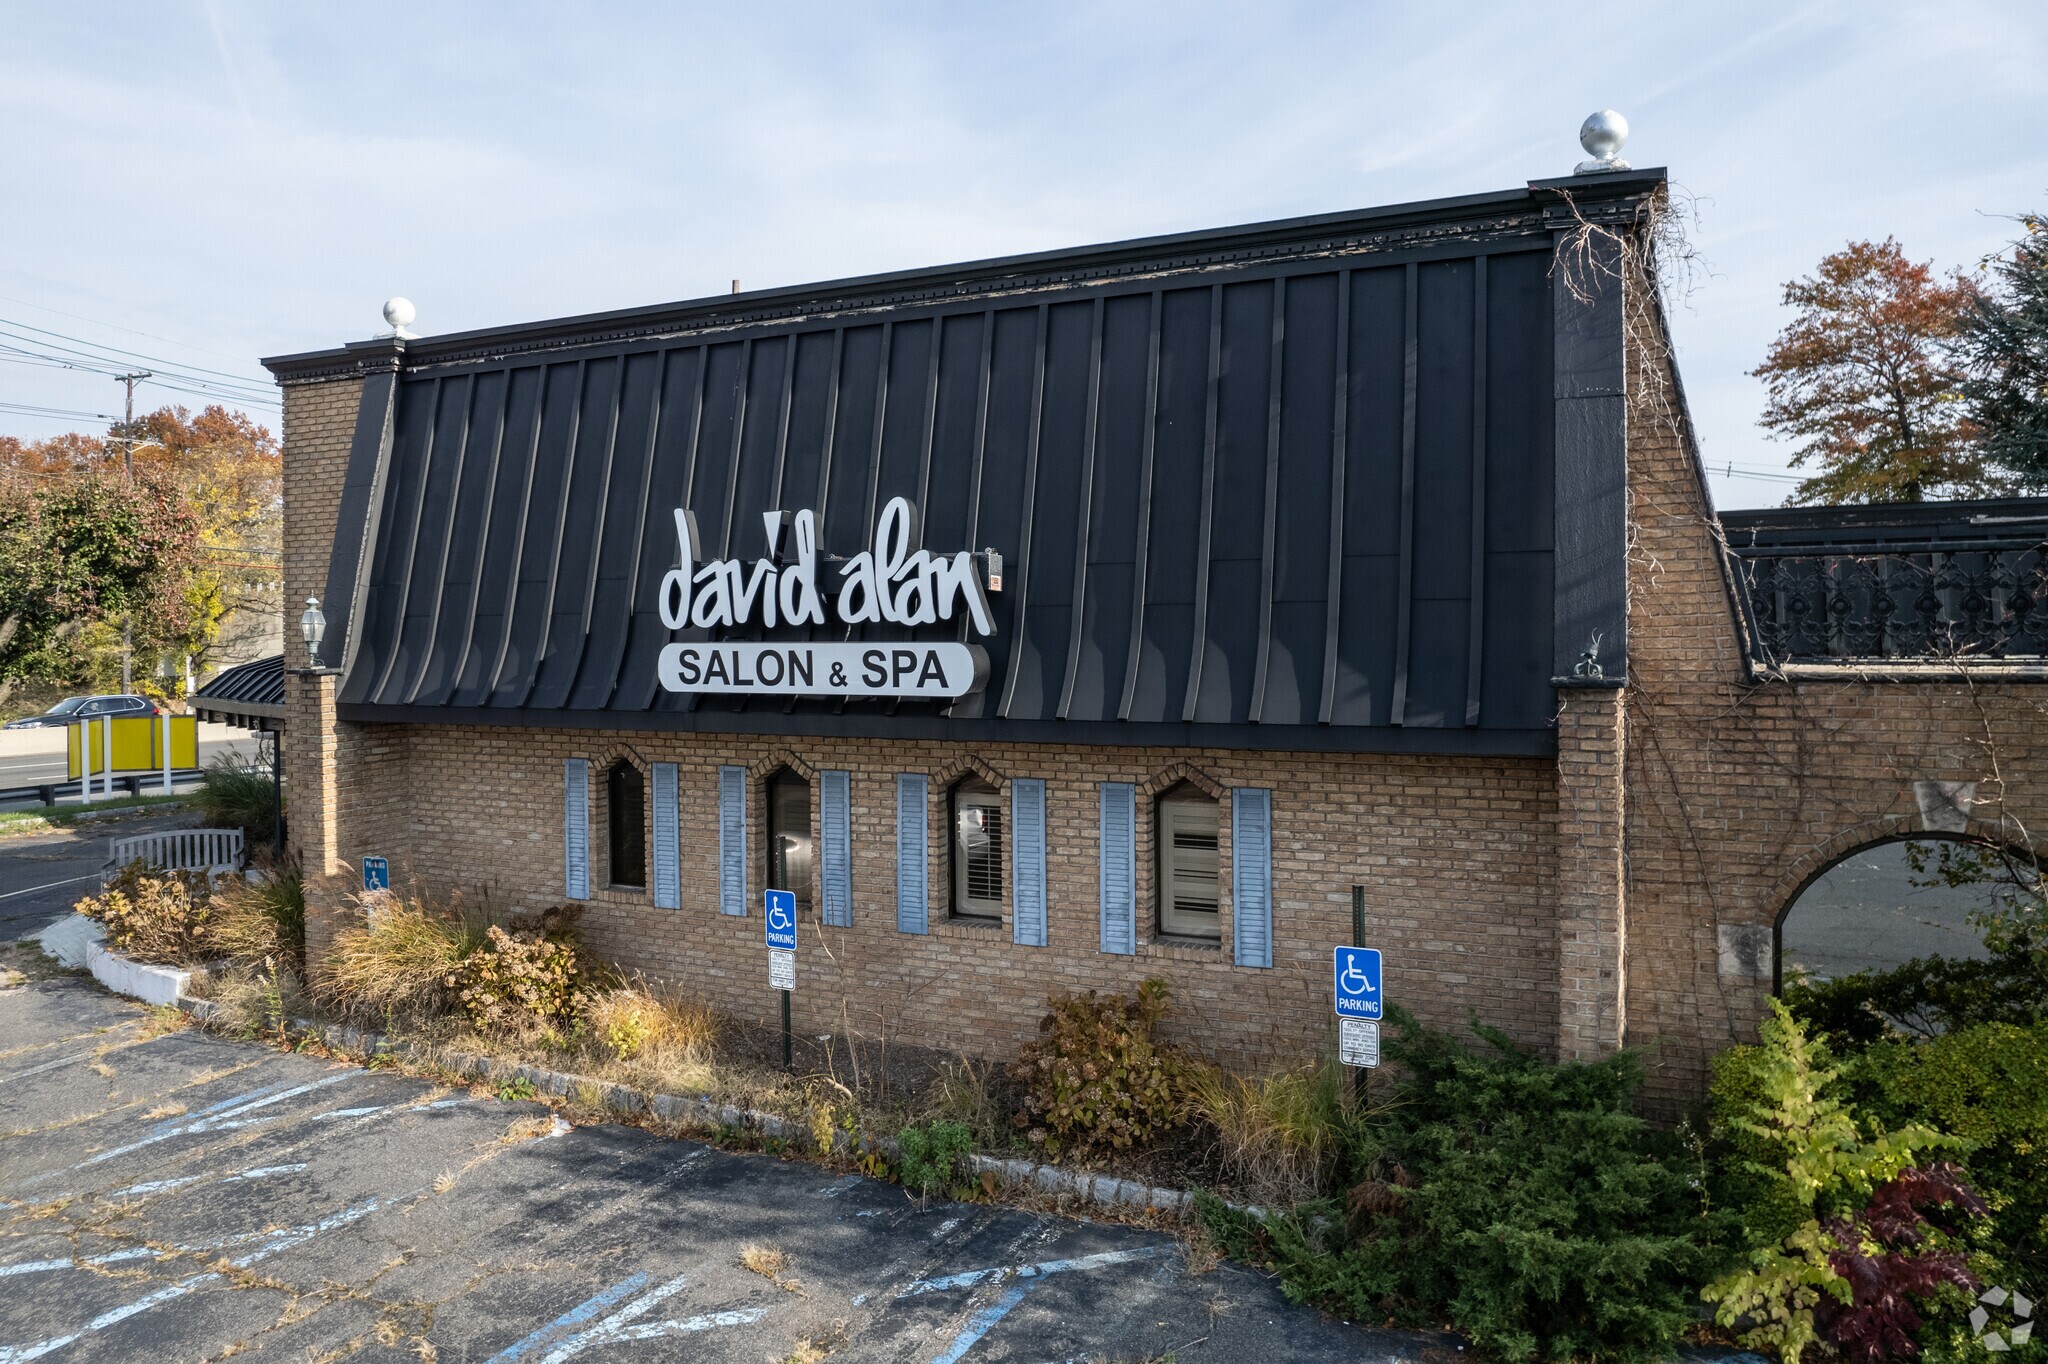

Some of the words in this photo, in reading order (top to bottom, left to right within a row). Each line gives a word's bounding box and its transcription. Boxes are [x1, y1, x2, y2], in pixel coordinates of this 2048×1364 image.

[658, 508, 825, 630] david
[837, 496, 994, 636] alan
[678, 649, 814, 687] SALON
[829, 661, 849, 688] &
[861, 650, 950, 689] SPA
[768, 932, 794, 944] PARKING
[1339, 998, 1378, 1012] PARKING
